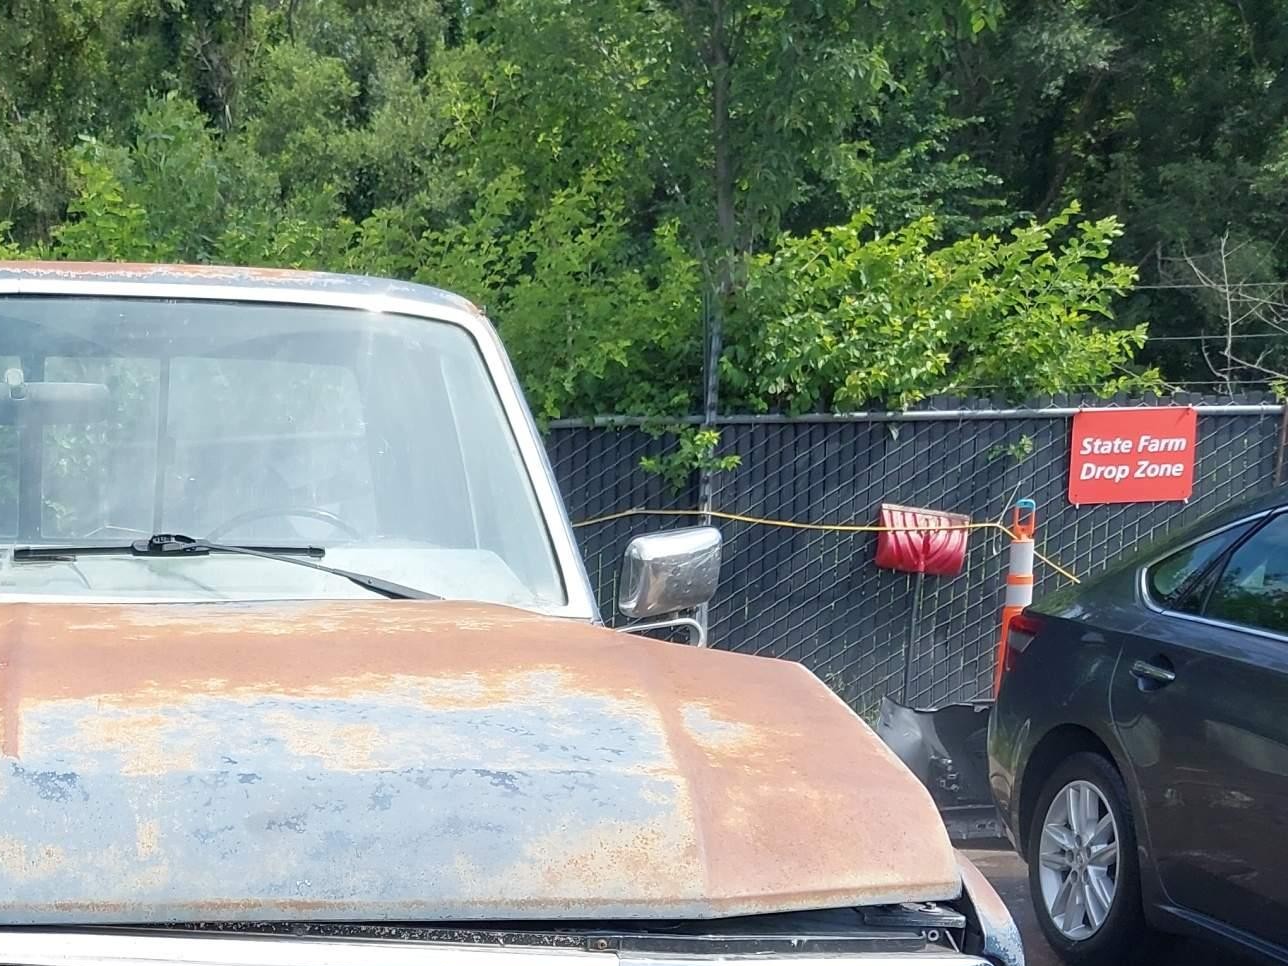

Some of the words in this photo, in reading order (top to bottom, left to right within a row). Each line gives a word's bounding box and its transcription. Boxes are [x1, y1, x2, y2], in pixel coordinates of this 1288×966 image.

[1079, 437, 1133, 455] State
[1137, 435, 1187, 453] Farm
[1079, 462, 1130, 483] Drop
[1133, 460, 1185, 478] Zone
